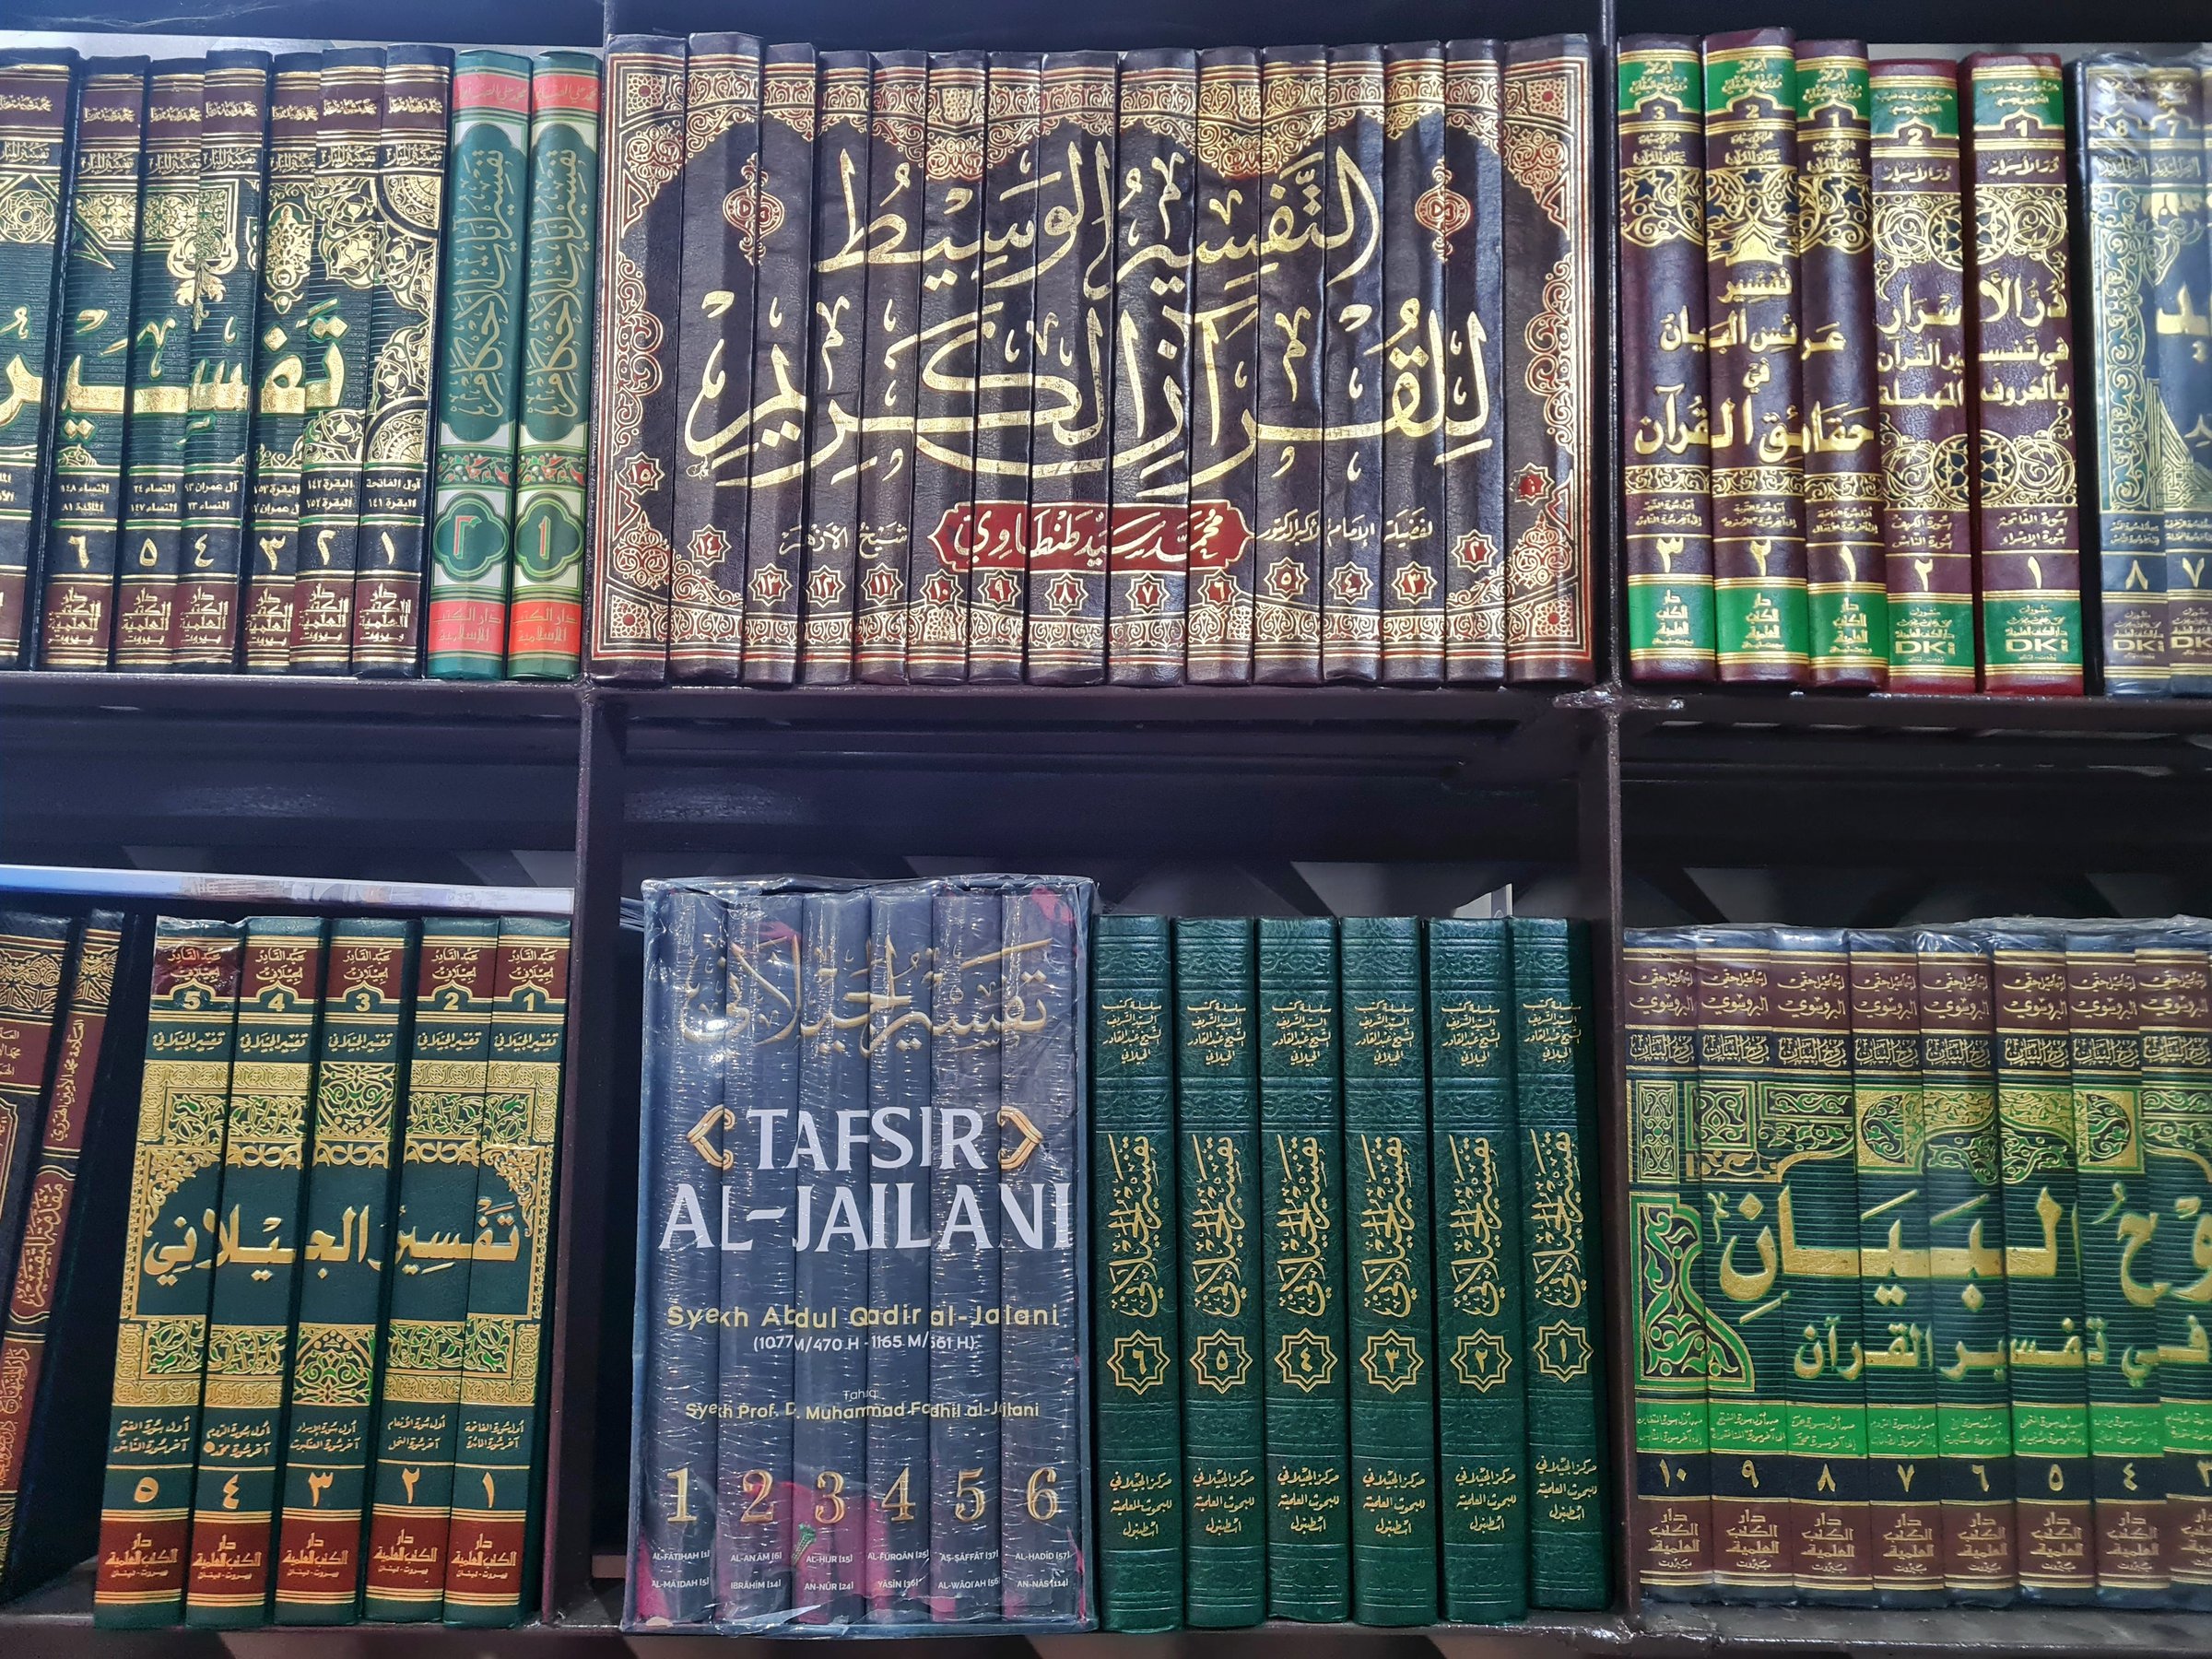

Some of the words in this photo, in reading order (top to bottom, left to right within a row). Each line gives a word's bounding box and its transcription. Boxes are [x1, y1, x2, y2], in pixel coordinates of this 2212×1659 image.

[1908, 127, 1924, 146] 2
[2015, 120, 2028, 137] 1
[2039, 336, 2069, 371] في
[1743, 358, 1770, 394] في
[632, 464, 652, 483] ١٥
[68, 535, 89, 569] ٦
[194, 534, 214, 568] ٤
[317, 530, 335, 565] ٢
[381, 531, 394, 565] ١
[538, 515, 551, 560] ١
[698, 538, 720, 554] ١٤
[1471, 544, 1478, 559] ٢
[139, 538, 158, 567] ٥
[260, 535, 286, 571] ٣
[1656, 536, 1684, 573] ٣
[1750, 539, 1771, 576] ٢
[1840, 545, 1856, 582] ١
[759, 575, 778, 596] ١٣
[1346, 574, 1354, 593] ٤
[1407, 576, 1419, 592] ٣
[1914, 559, 1933, 591] ٢
[2028, 556, 2041, 588] ١
[2125, 559, 2147, 590] ٨
[2183, 557, 2205, 588] ٧
[994, 580, 1003, 598] ٩
[1060, 585, 1073, 602] ٨
[184, 991, 201, 1010] 5
[268, 993, 285, 1011] 4
[355, 993, 371, 1012] 3
[443, 992, 459, 1010] 2
[523, 993, 535, 1011] 1
[746, 1107, 984, 1171] TAFSIR
[658, 1182, 1075, 1252] AL-JAILANI
[667, 1306, 748, 1330] Syekh
[761, 1304, 837, 1328] Abdul
[850, 1304, 922, 1327] Qadir
[1132, 1349, 1147, 1375] ٦
[1216, 1349, 1229, 1371] ٥
[1300, 1347, 1313, 1372] ٤
[1384, 1348, 1400, 1373] ٣
[1475, 1348, 1488, 1373] ٢
[1559, 1337, 1567, 1362] ١
[738, 1404, 779, 1418] Prof.
[806, 1402, 905, 1420] Muhammad
[402, 1467, 420, 1504] ٢
[1659, 1458, 1688, 1488] ١٠
[1741, 1459, 1759, 1488] ٩
[1818, 1464, 1836, 1492] ٨
[1897, 1464, 1915, 1492] ٧
[1971, 1464, 1990, 1492] ٦
[2048, 1464, 2064, 1492] ٥
[2123, 1462, 2138, 1491] ٤
[134, 1477, 159, 1503] ٥
[223, 1474, 239, 1510] ٤
[308, 1471, 334, 1507] ٣
[482, 1472, 495, 1509] ١
[667, 1467, 697, 1523] 1
[740, 1469, 773, 1523] 2
[816, 1471, 845, 1524] 3
[881, 1467, 915, 1521] 4
[955, 1467, 985, 1521] 5
[1027, 1467, 1058, 1521] 6
